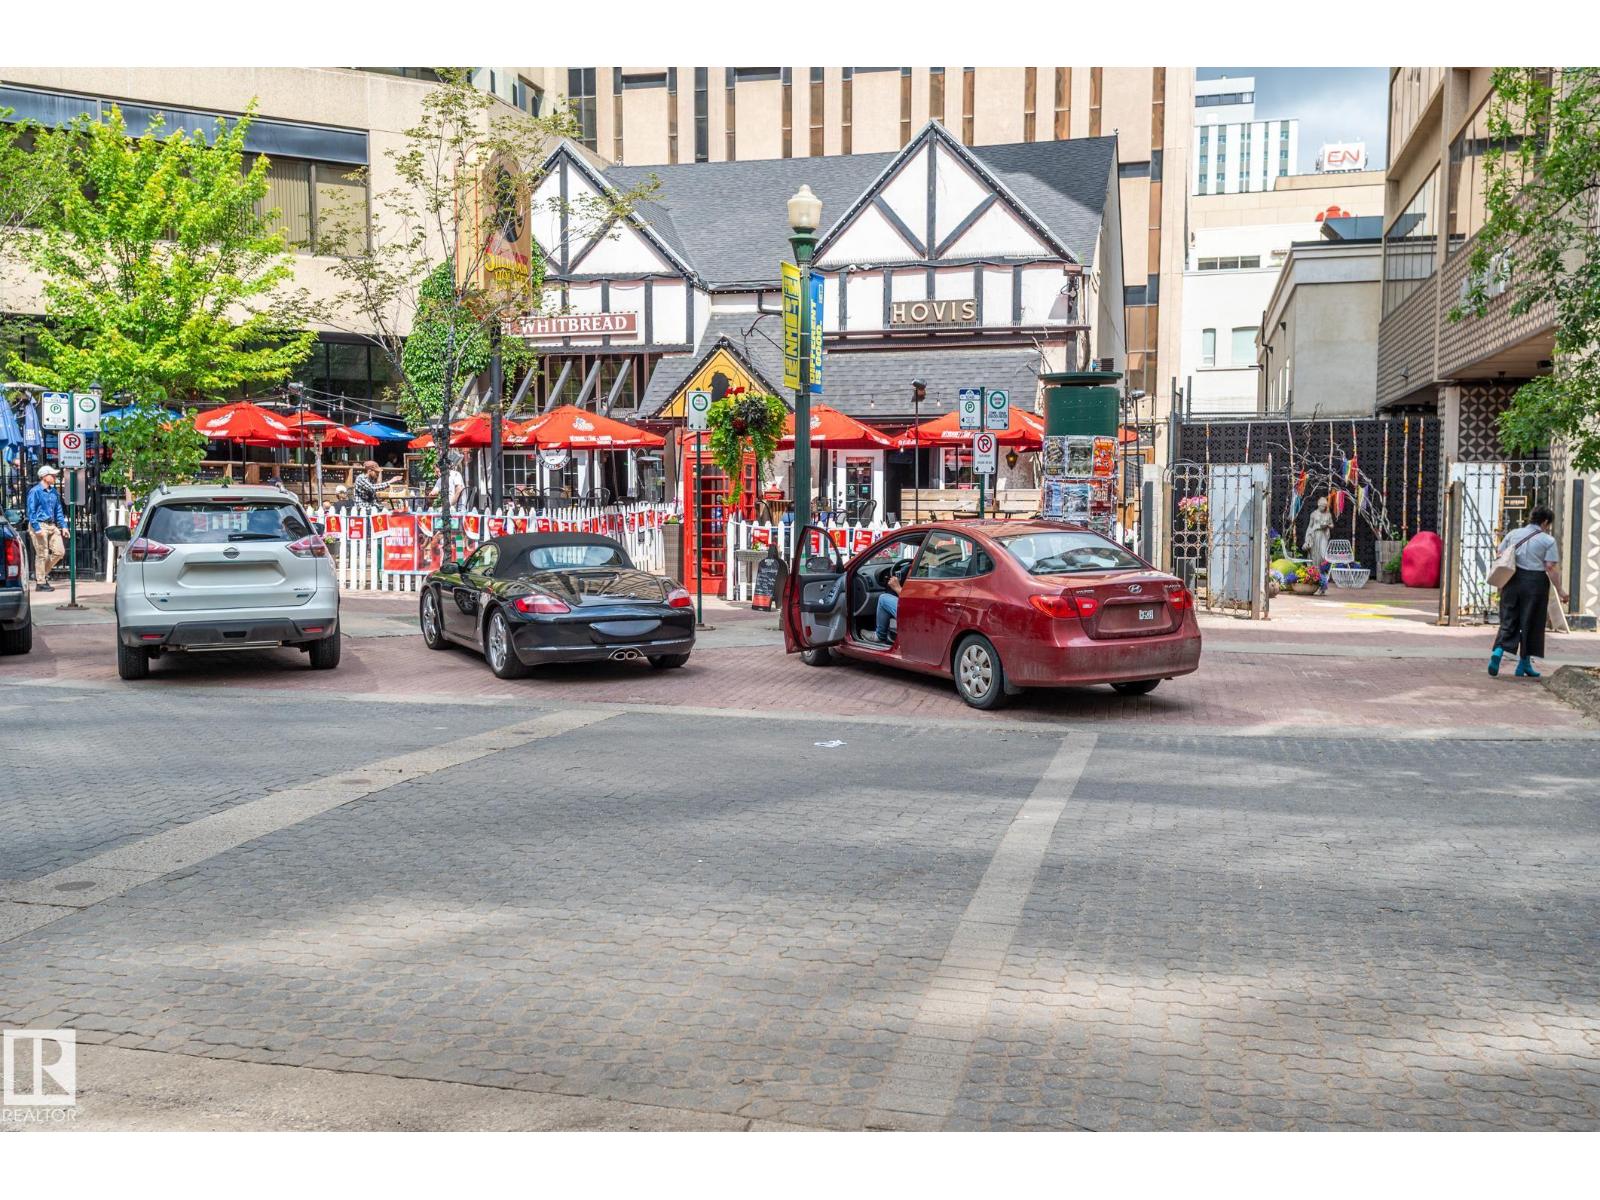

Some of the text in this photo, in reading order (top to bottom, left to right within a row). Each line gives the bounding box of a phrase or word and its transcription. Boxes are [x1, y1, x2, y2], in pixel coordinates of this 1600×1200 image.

[892, 301, 975, 322] HOVIS
[520, 315, 627, 334] WHITBREAD
[809, 299, 817, 384] DIFFERENT
